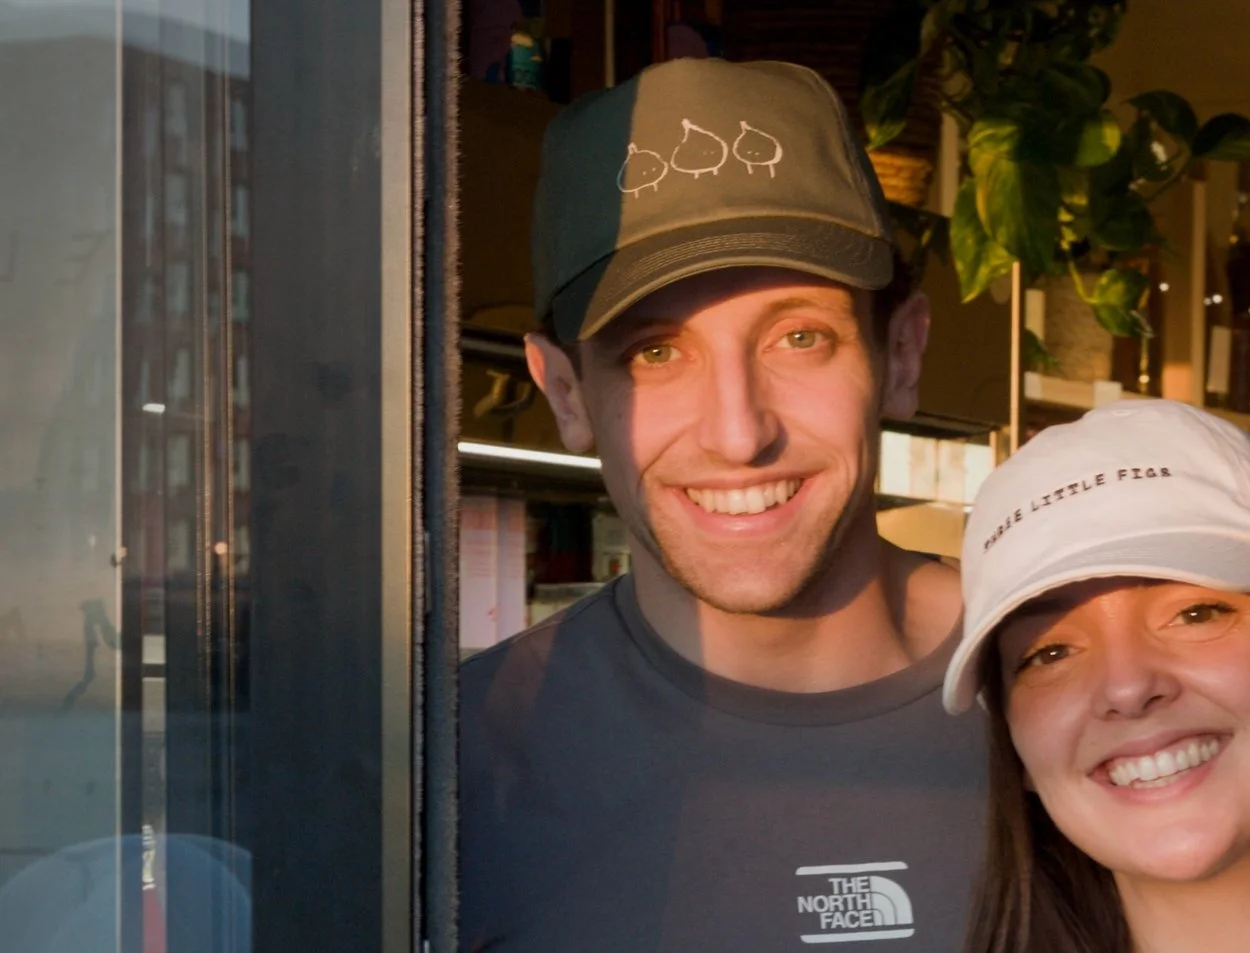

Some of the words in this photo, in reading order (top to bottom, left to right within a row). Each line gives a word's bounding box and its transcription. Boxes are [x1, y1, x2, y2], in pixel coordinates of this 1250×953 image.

[983, 509, 1023, 553] THREE
[1031, 473, 1106, 512] LITTLE
[1117, 467, 1172, 481] FIGS
[828, 876, 869, 893] THE
[797, 893, 871, 913] NORTH
[820, 911, 874, 929] FACE
